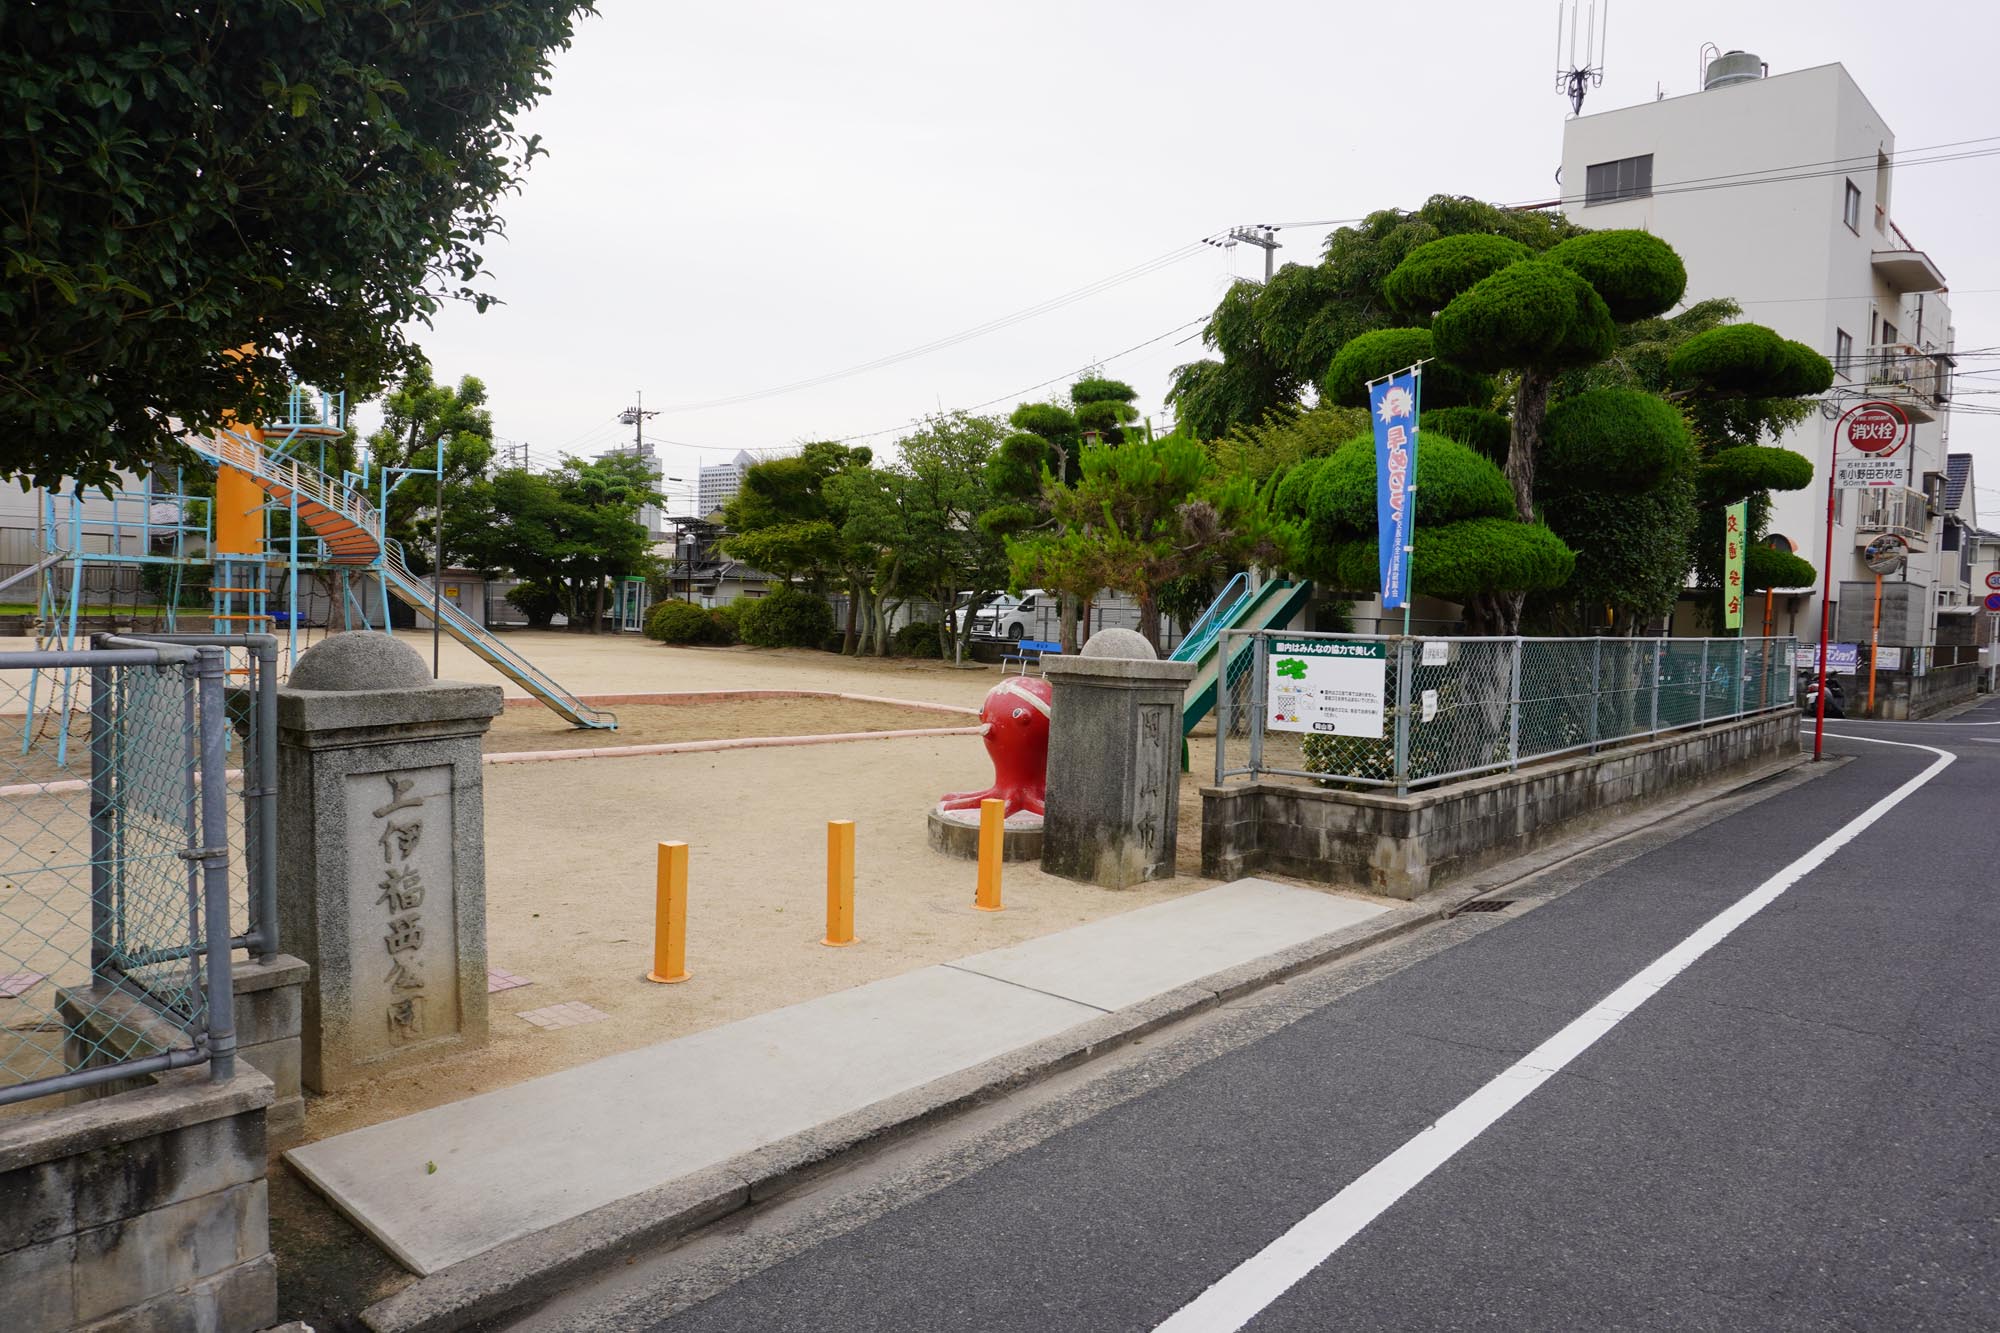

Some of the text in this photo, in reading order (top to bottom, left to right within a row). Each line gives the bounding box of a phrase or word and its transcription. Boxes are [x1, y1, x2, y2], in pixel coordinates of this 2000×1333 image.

[1851, 423, 1894, 440] 消火栓
[1276, 642, 1376, 656] 園内はみんなの協力で美しく
[372, 775, 426, 1047] 上伊福西公園
